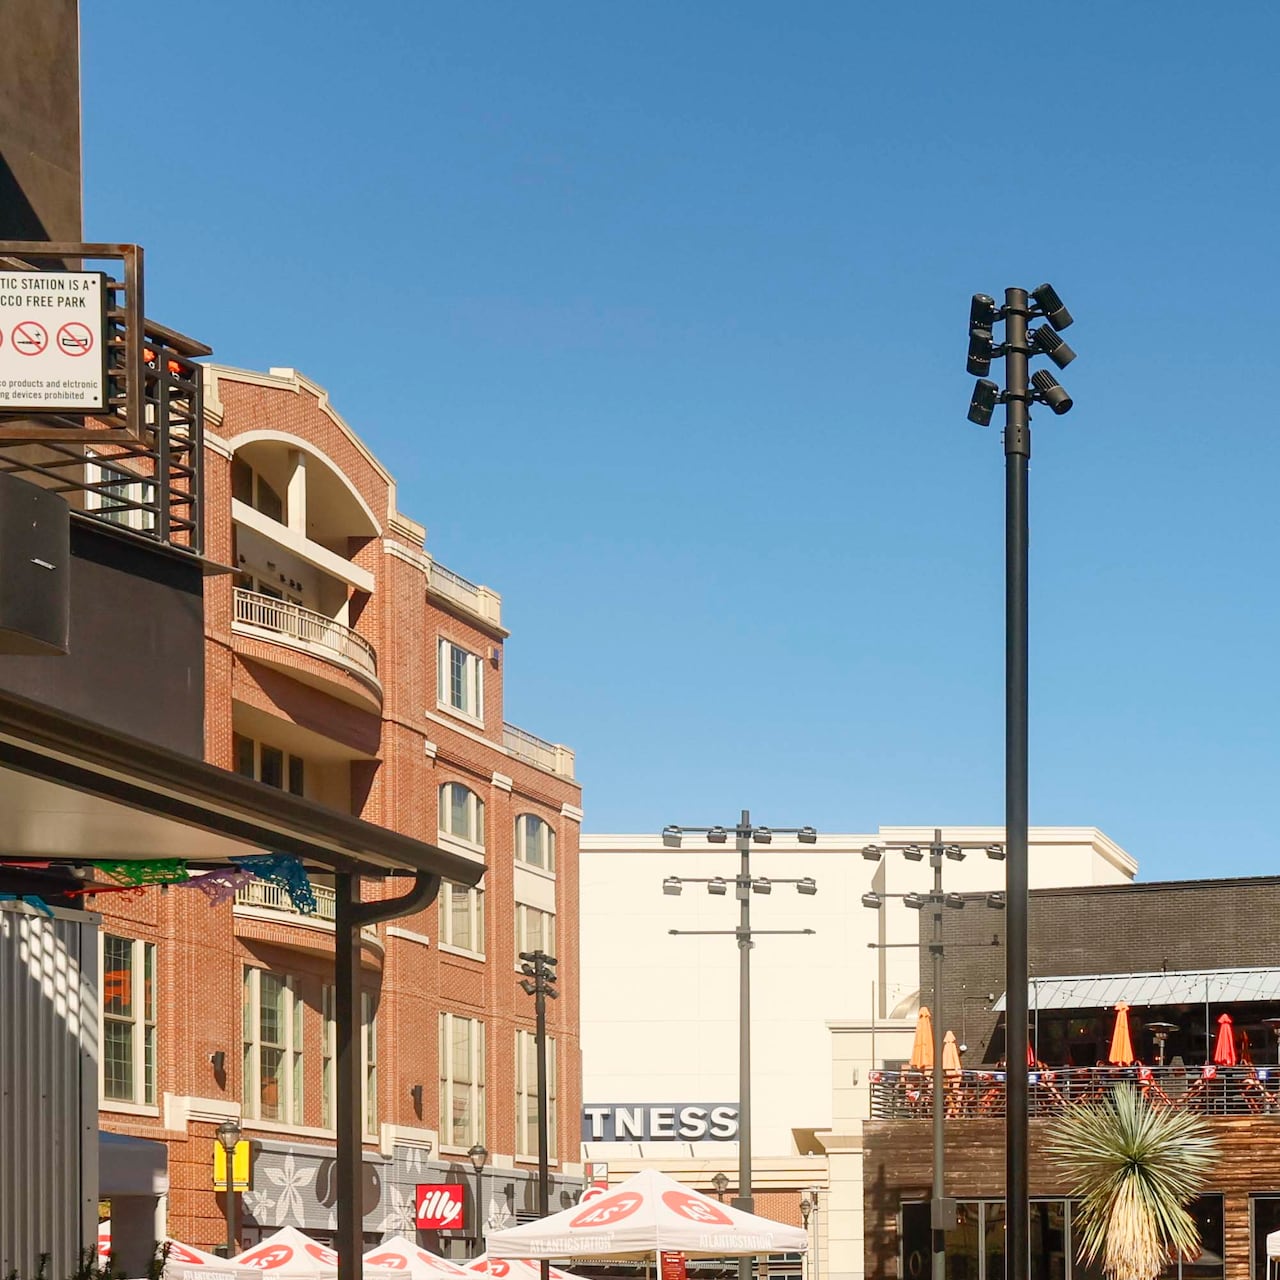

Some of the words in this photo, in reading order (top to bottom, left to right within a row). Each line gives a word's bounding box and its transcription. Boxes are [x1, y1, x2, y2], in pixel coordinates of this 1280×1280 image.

[21, 279, 65, 290] STATION
[69, 280, 79, 291] IS
[82, 280, 90, 291] A
[26, 296, 54, 307] FREE
[57, 297, 86, 307] PARK
[9, 379, 43, 388] products
[46, 380, 60, 388] and
[63, 380, 98, 388] elctronic
[12, 390, 42, 399] devices
[44, 391, 84, 400] prohibited
[584, 1106, 740, 1140] TNESS
[418, 1190, 462, 1226] illy
[530, 1235, 612, 1254] ATLANTICSTATION
